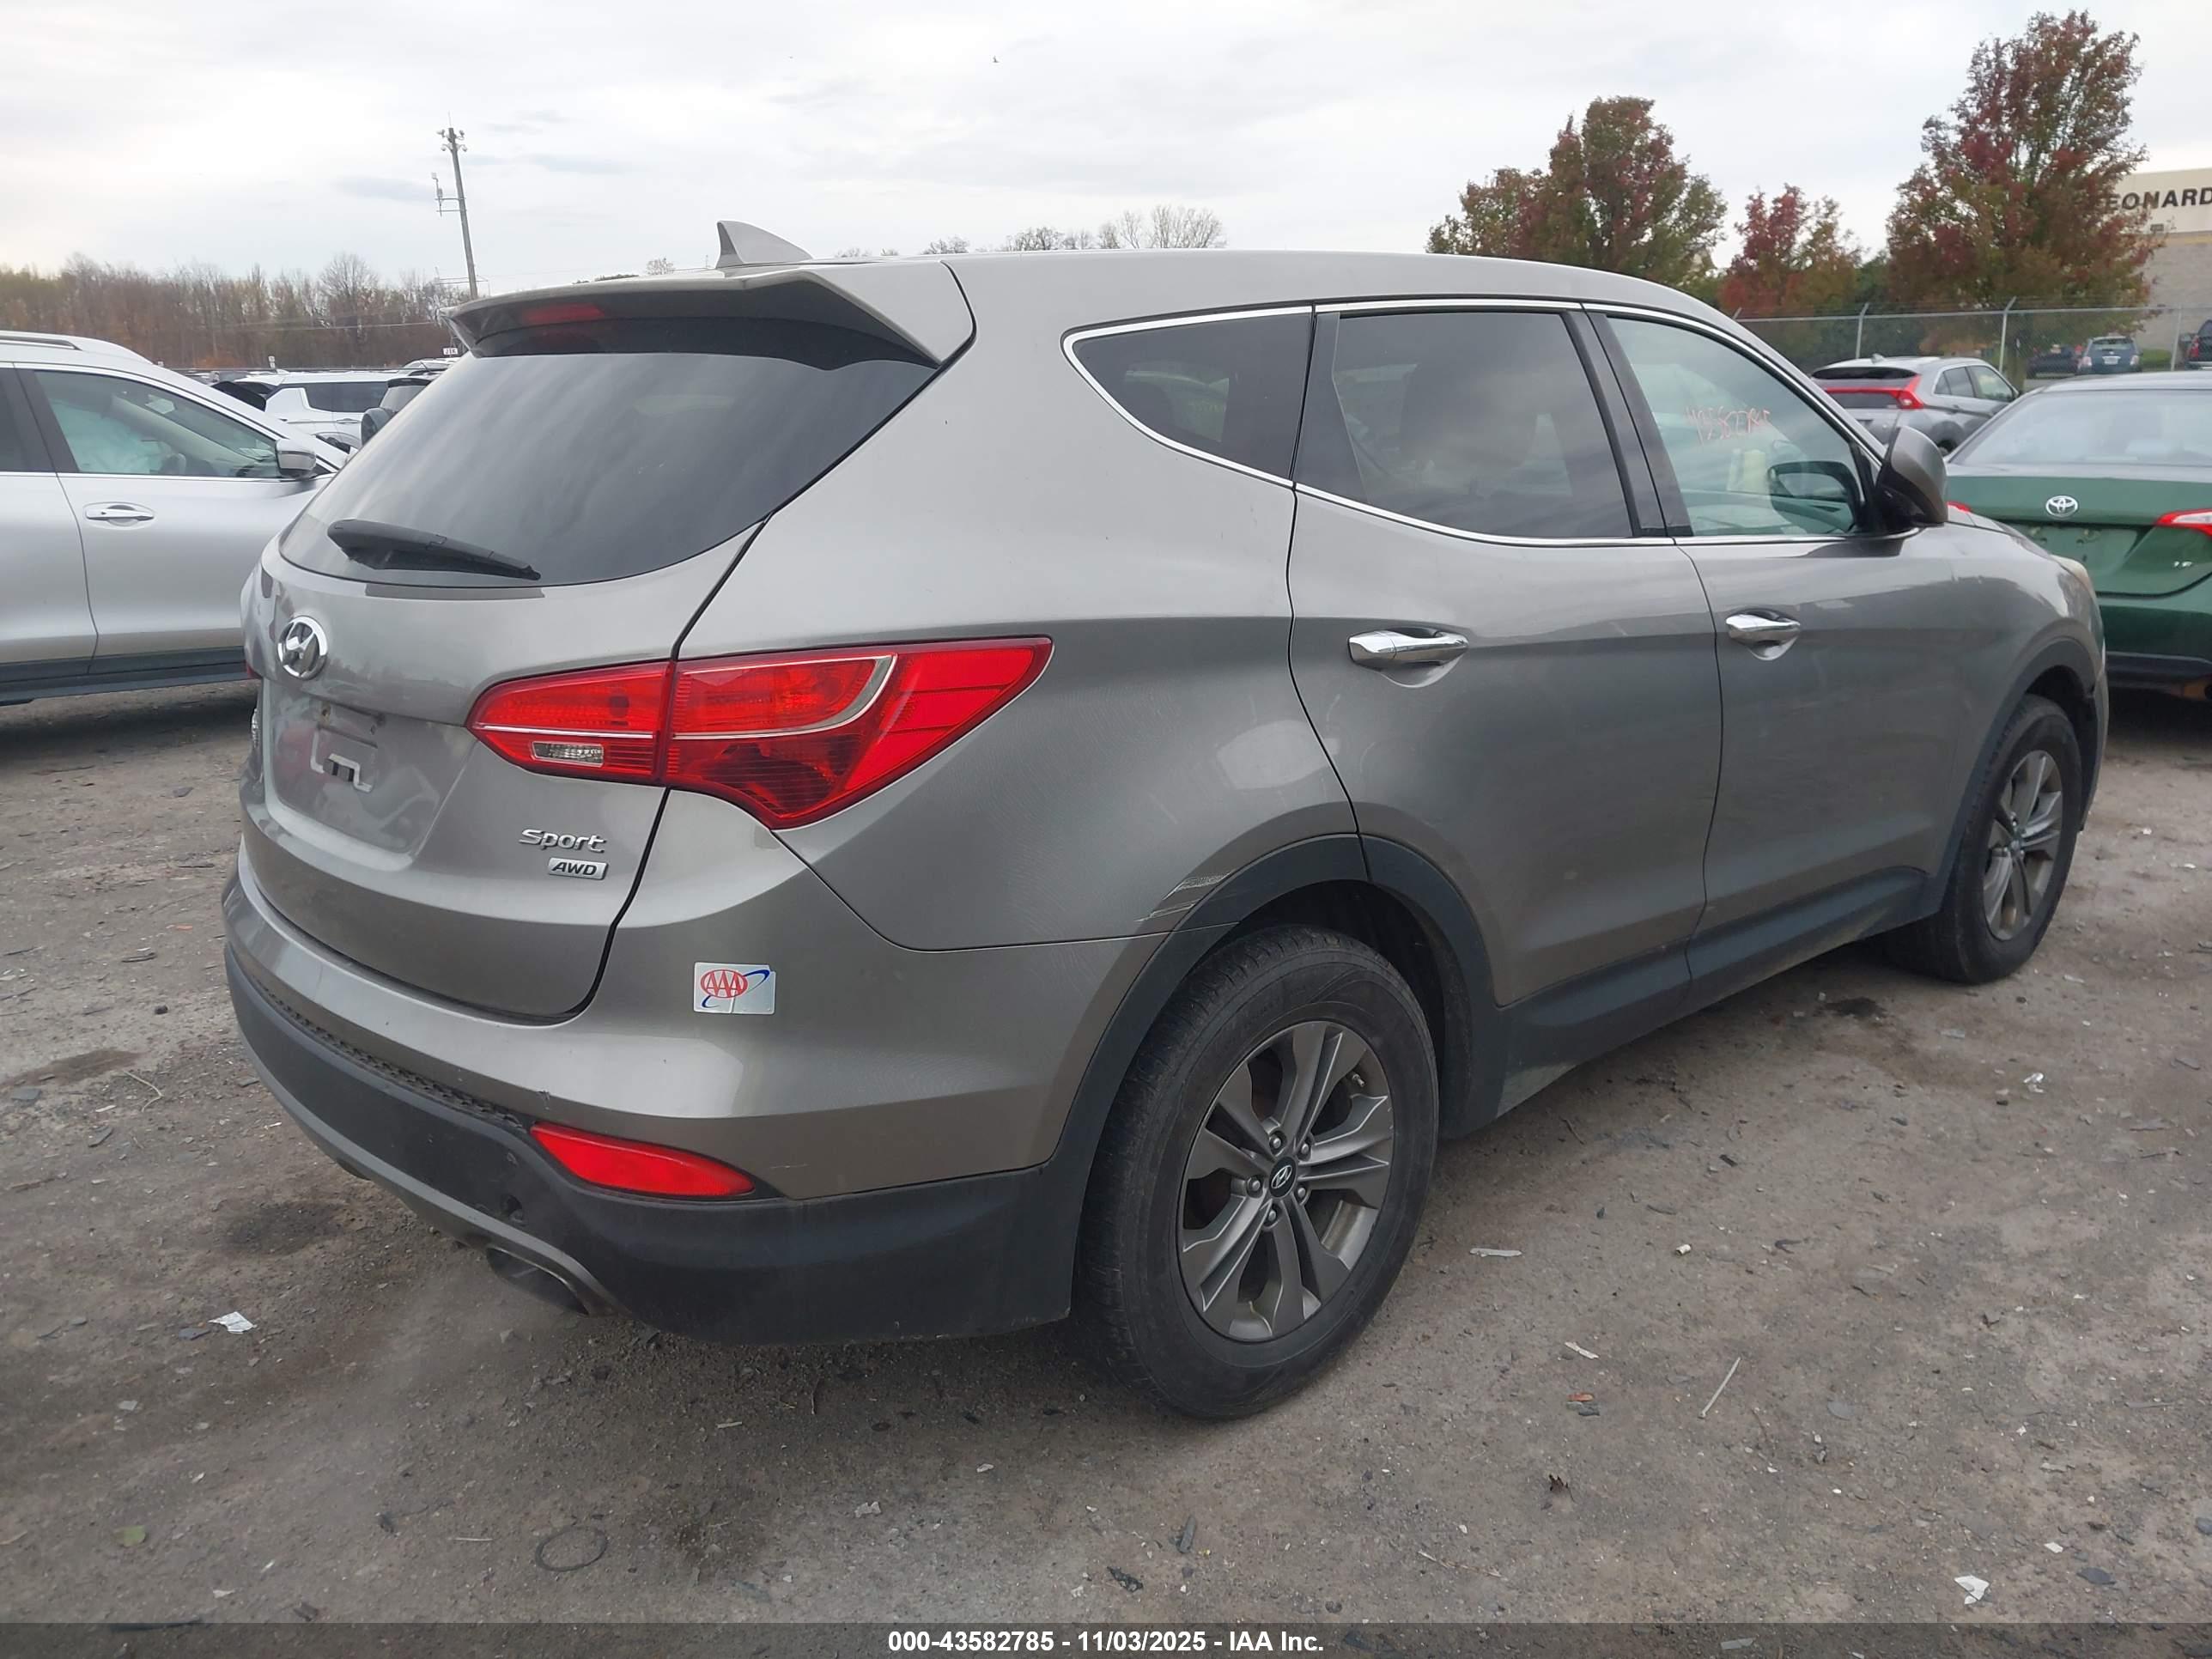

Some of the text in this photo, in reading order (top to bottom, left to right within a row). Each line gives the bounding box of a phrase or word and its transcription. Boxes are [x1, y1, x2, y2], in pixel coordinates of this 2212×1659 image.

[519, 829, 606, 854] Sport
[551, 861, 599, 876] AWD
[703, 969, 746, 998] AAA
